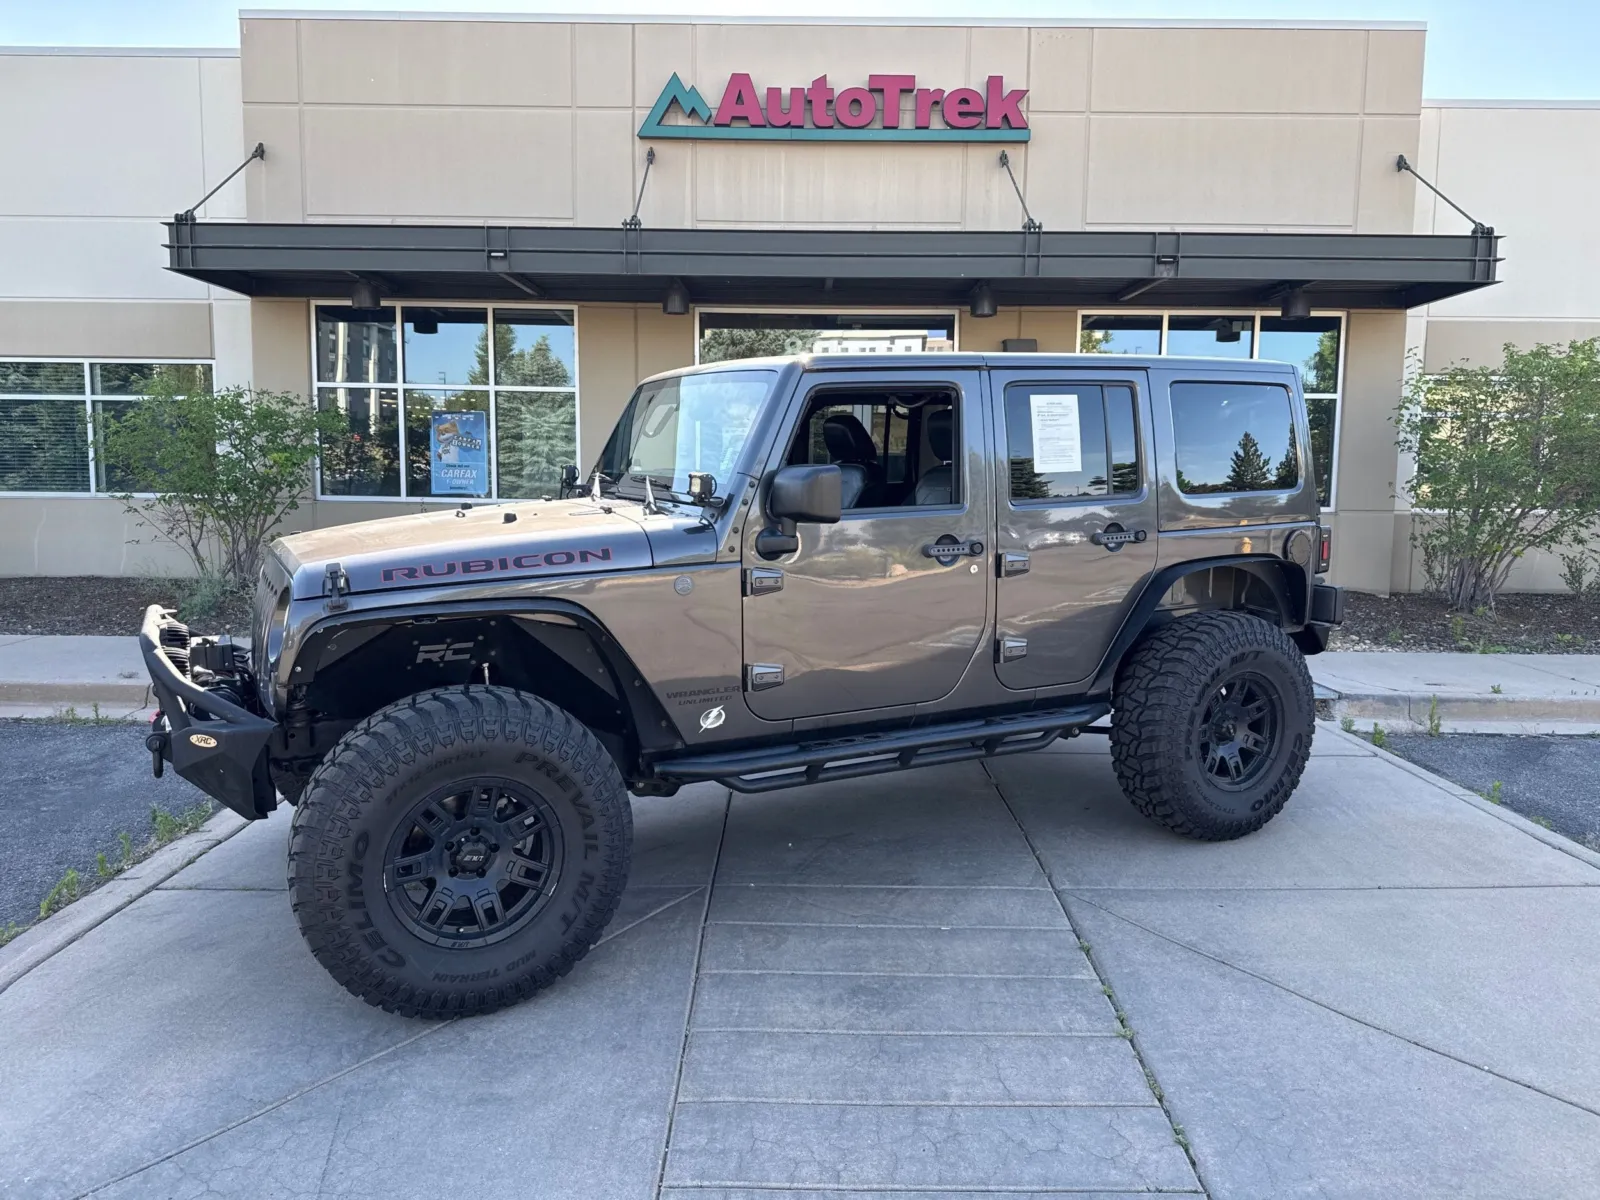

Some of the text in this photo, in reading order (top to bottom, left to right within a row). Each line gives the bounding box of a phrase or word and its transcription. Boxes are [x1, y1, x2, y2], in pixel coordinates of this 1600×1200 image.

[713, 72, 1029, 129] AutoTrek
[440, 469, 477, 479] CARFAX
[380, 547, 613, 583] RUBICON
[416, 642, 475, 664] RC
[665, 685, 741, 699] WRANGLER
[678, 695, 733, 706] UNLIMITED
[195, 735, 212, 745] XRC
[513, 751, 599, 860] PREVAIL
[347, 830, 407, 968] CELIMO
[431, 968, 501, 984] TERRAIN
